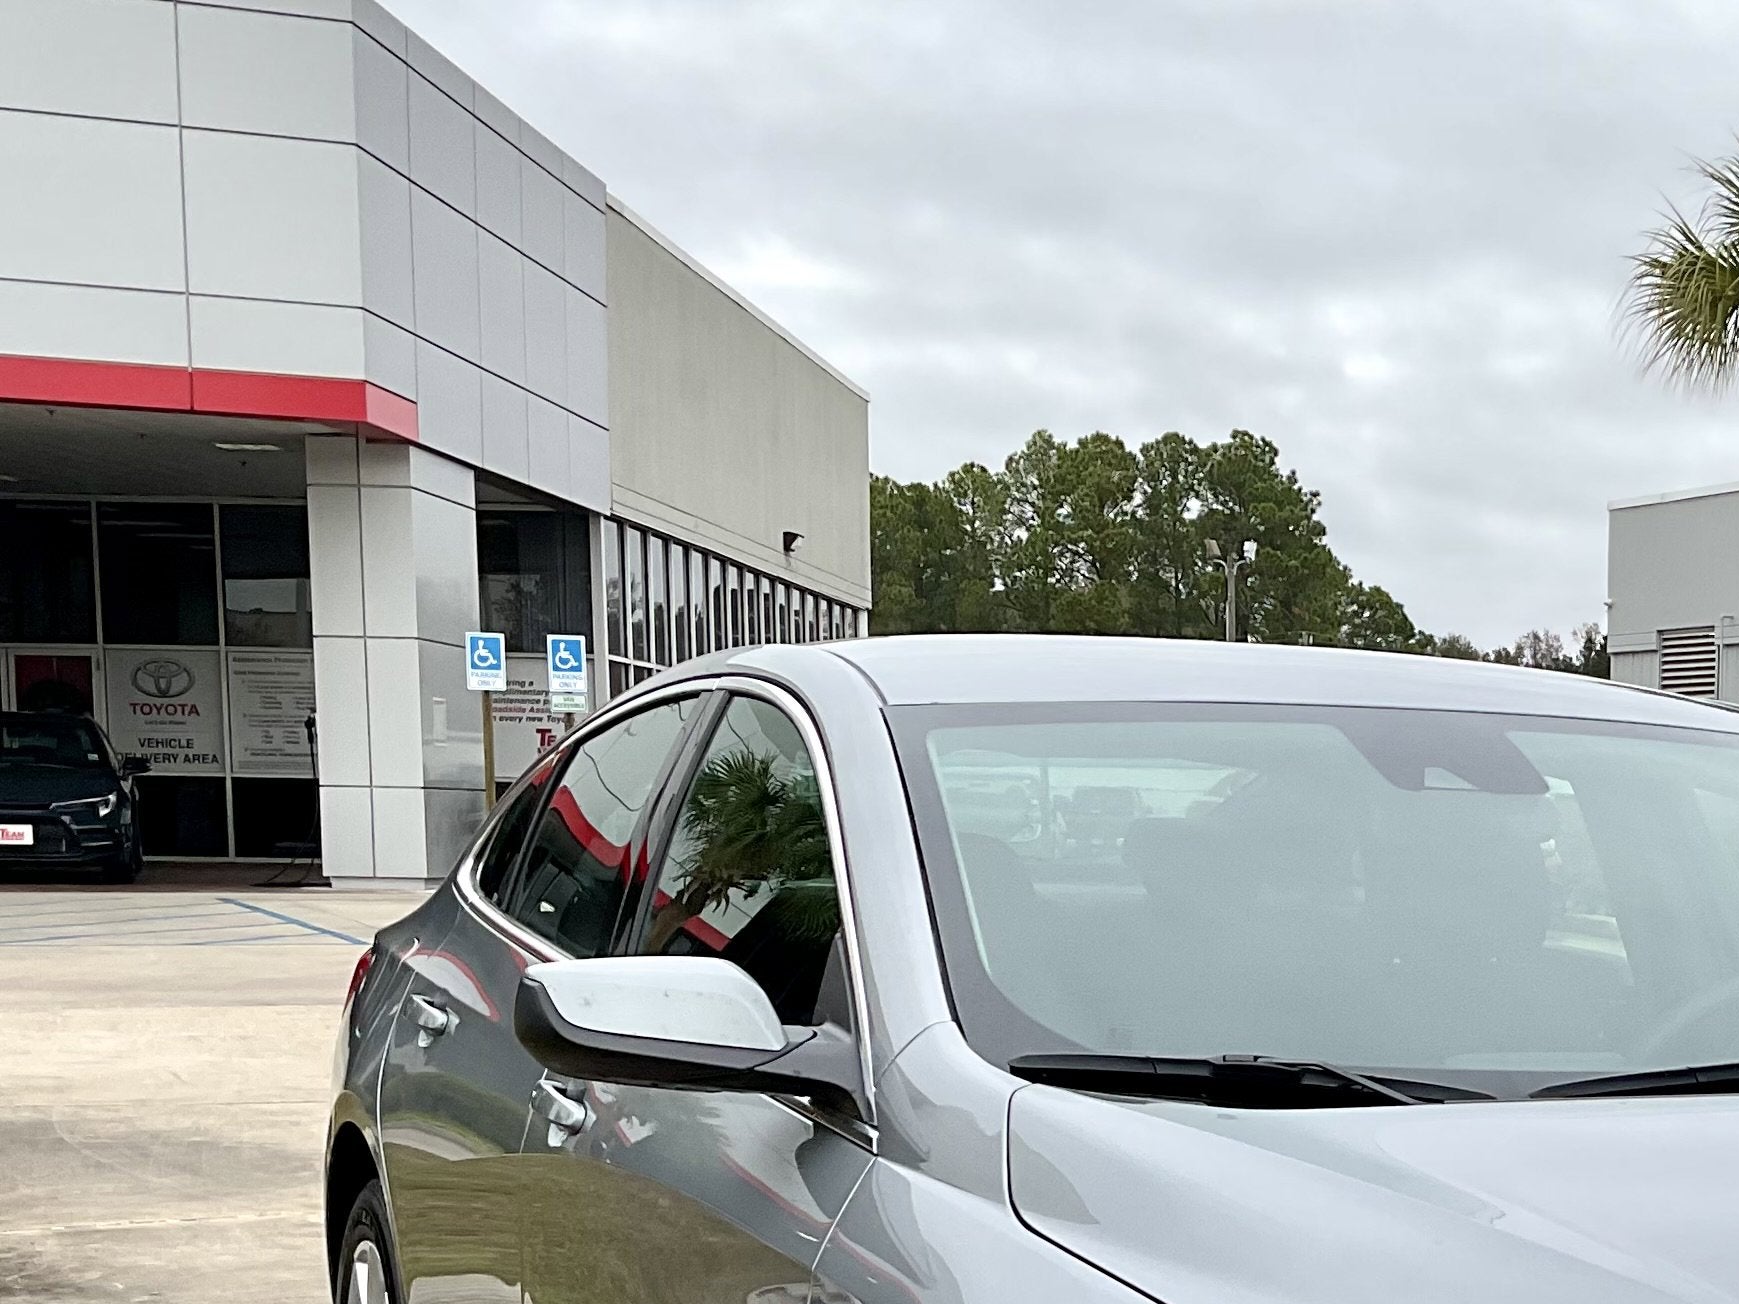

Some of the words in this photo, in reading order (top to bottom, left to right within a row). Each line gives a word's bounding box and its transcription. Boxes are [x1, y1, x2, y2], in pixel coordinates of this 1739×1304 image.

[129, 703, 200, 717] TOYOTA
[526, 714, 544, 722] new
[138, 738, 194, 749] VEHICLE
[536, 729, 557, 747] TE
[183, 753, 220, 764] AREA
